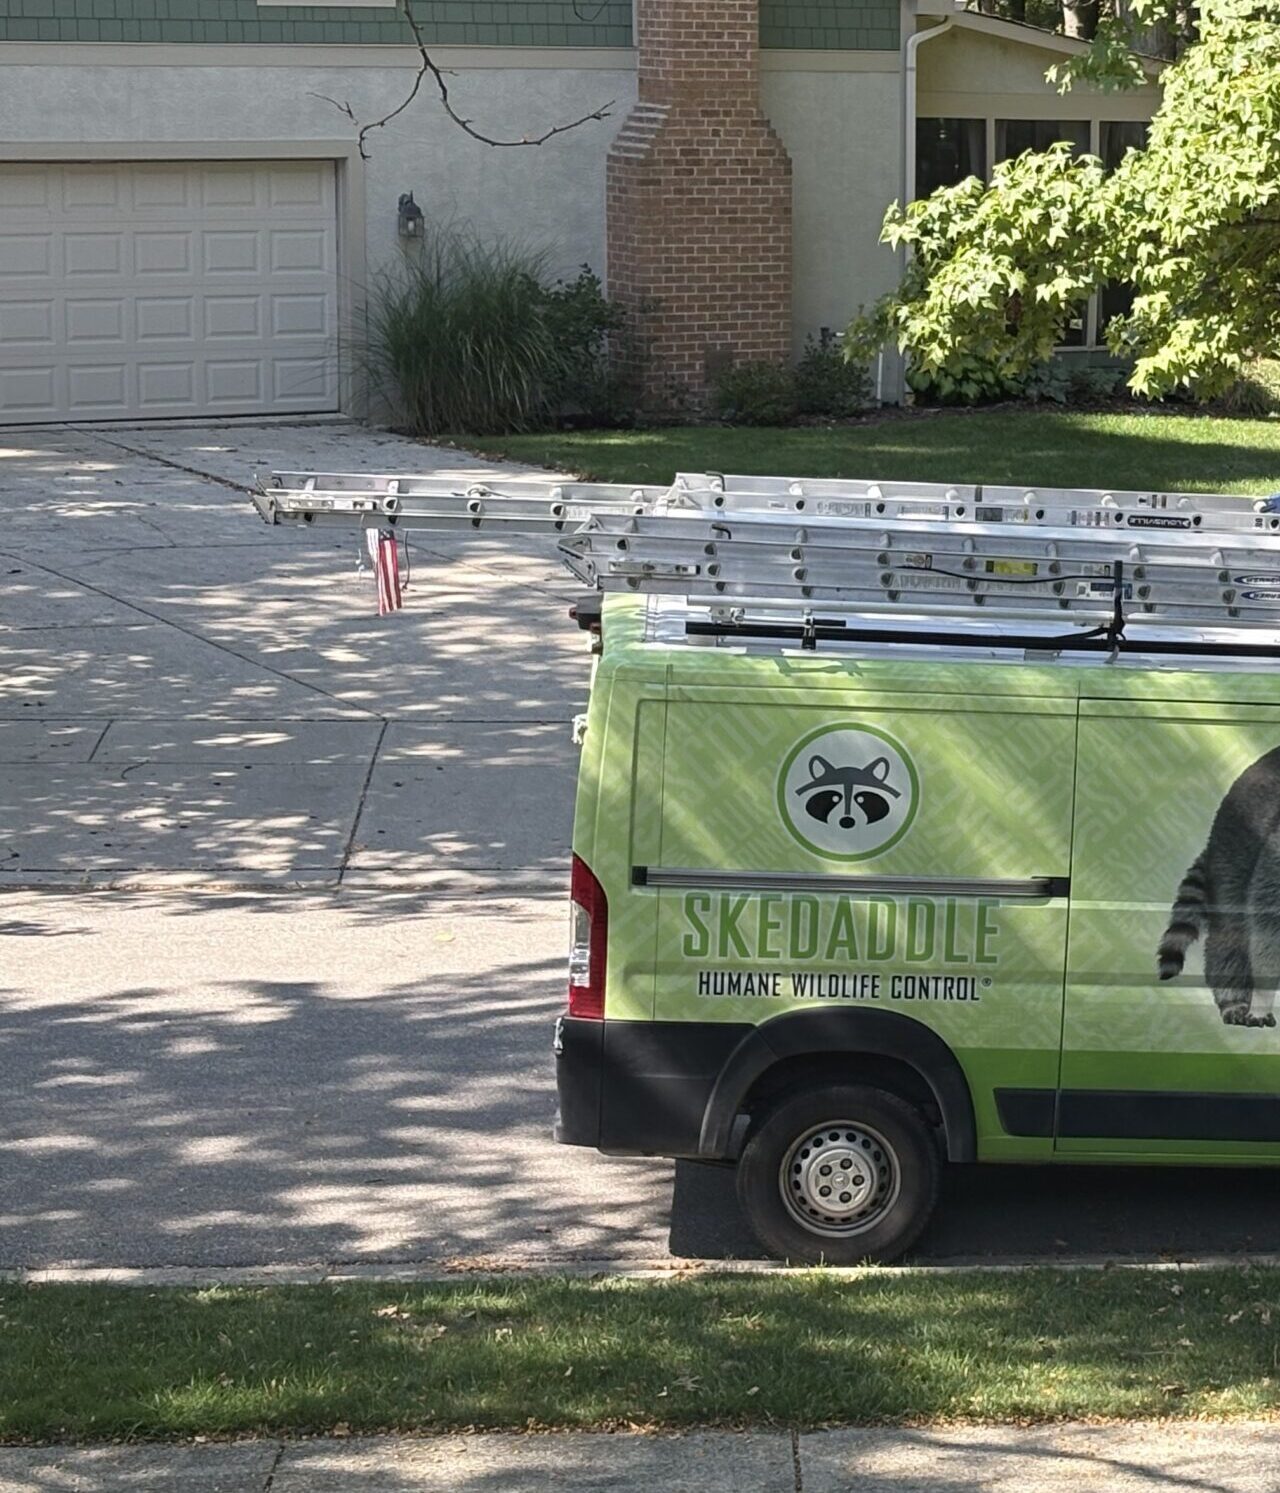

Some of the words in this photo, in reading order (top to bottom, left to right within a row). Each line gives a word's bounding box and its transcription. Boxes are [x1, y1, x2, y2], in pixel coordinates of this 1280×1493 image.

[1129, 517, 1183, 528] LOUISVILLE
[682, 892, 999, 963] SKEDADDLE
[698, 971, 782, 997] HUMANE
[791, 972, 882, 999] WILDLIFE
